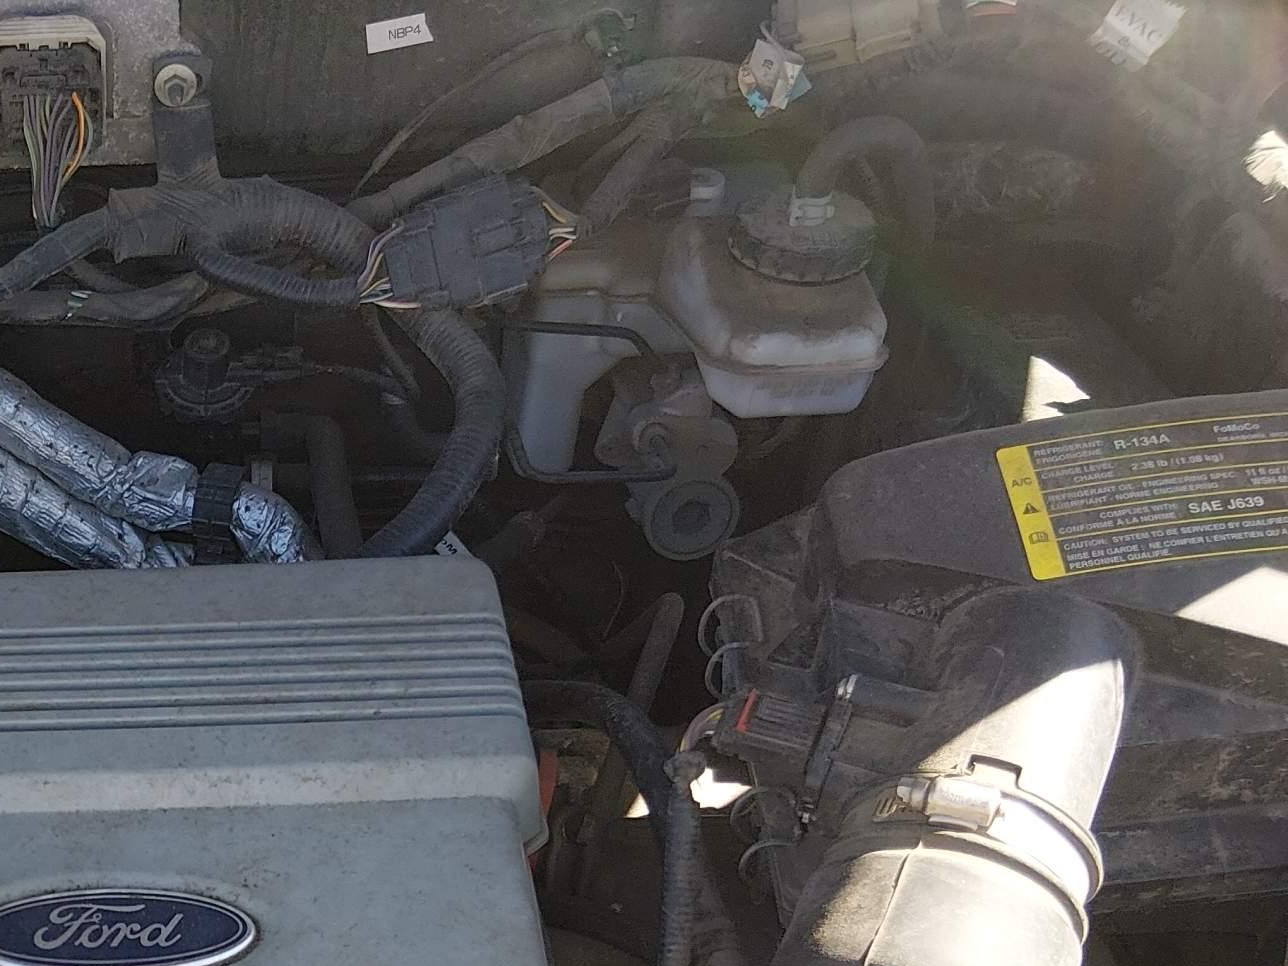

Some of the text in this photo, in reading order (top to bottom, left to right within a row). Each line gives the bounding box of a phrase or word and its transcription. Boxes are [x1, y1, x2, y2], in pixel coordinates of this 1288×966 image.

[388, 24, 421, 40] NBP4
[1113, 433, 1171, 450] R-134A
[1212, 424, 1260, 433] FoMoCo
[1083, 463, 1114, 473] LEVEL
[1011, 477, 1033, 488] A/C
[1073, 472, 1114, 483] CHARGE
[1188, 501, 1223, 514] SAE
[1227, 496, 1264, 510] J639
[1111, 533, 1151, 544] SYSTEM
[1180, 524, 1226, 535] SERVICED
[1092, 548, 1104, 557] EN
[1106, 545, 1139, 555] GARDE
[1069, 556, 1125, 570] PERSONNEL
[33, 903, 184, 950] Ford
